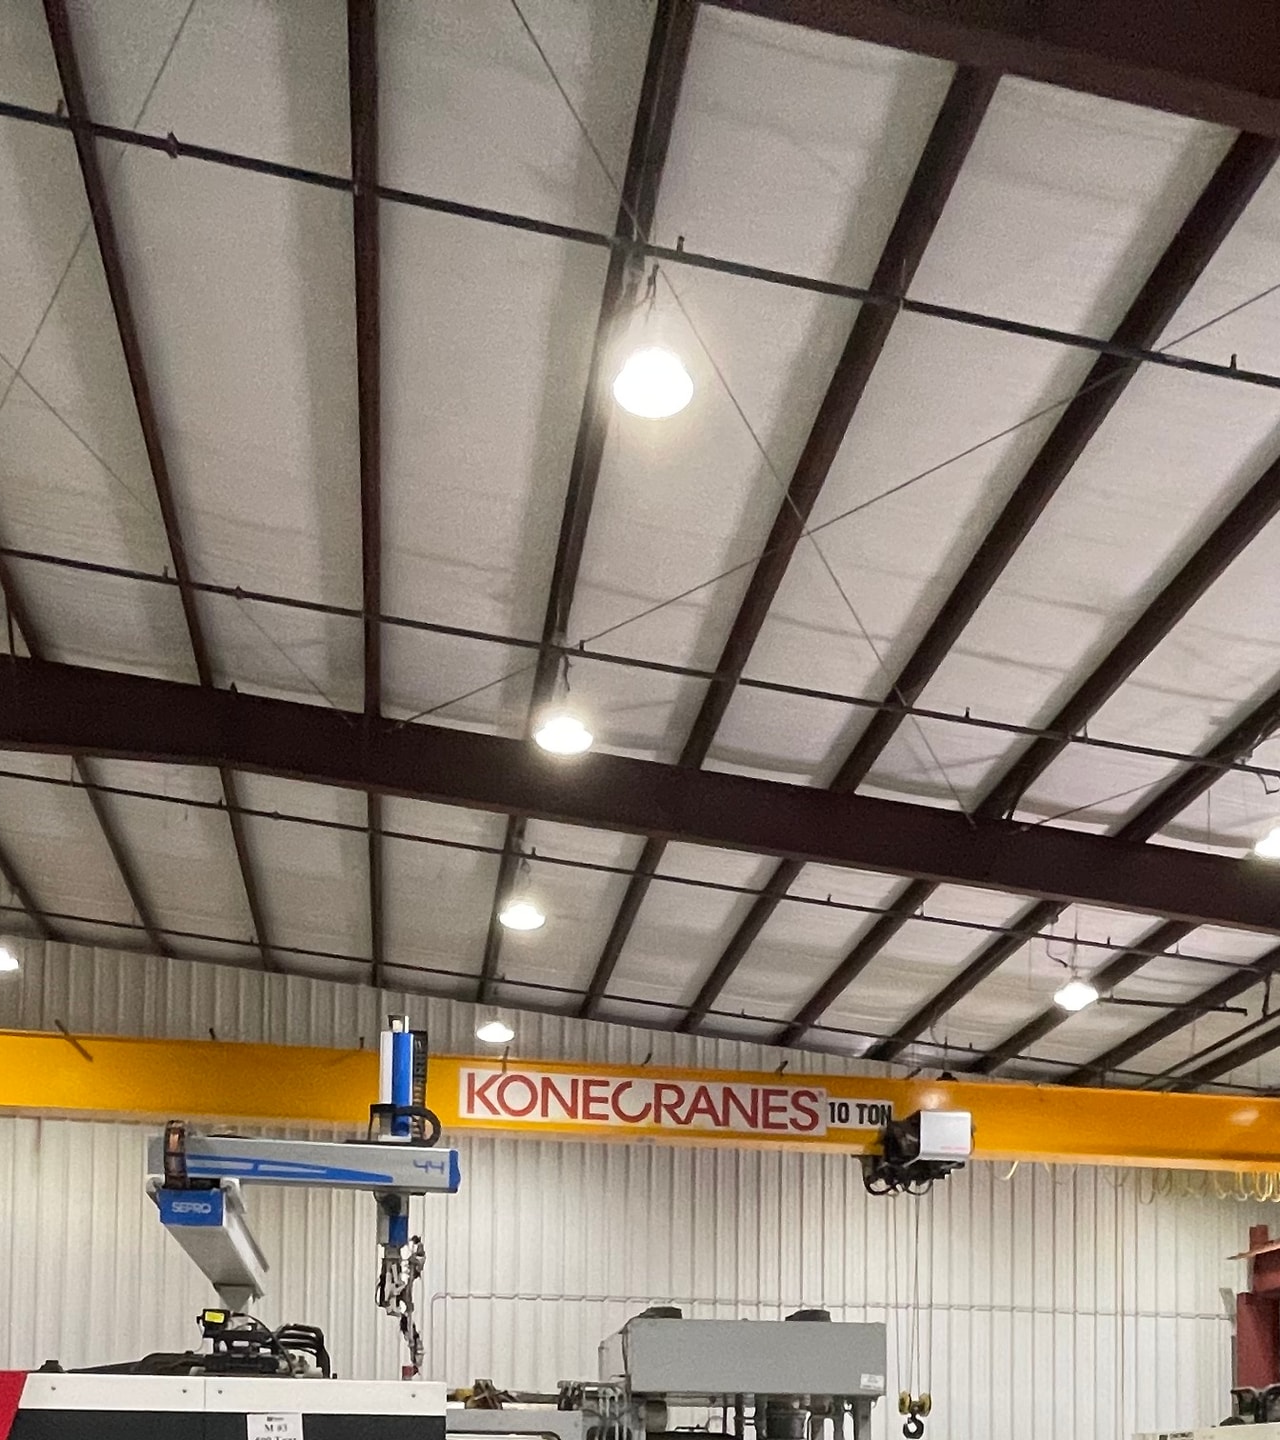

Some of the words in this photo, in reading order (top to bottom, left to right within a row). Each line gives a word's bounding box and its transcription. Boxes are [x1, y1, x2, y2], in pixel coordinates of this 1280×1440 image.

[467, 1073, 819, 1131] KONECRANES
[828, 1102, 850, 1123] 10
[856, 1103, 892, 1126] TON
[413, 1159, 445, 1175] 44
